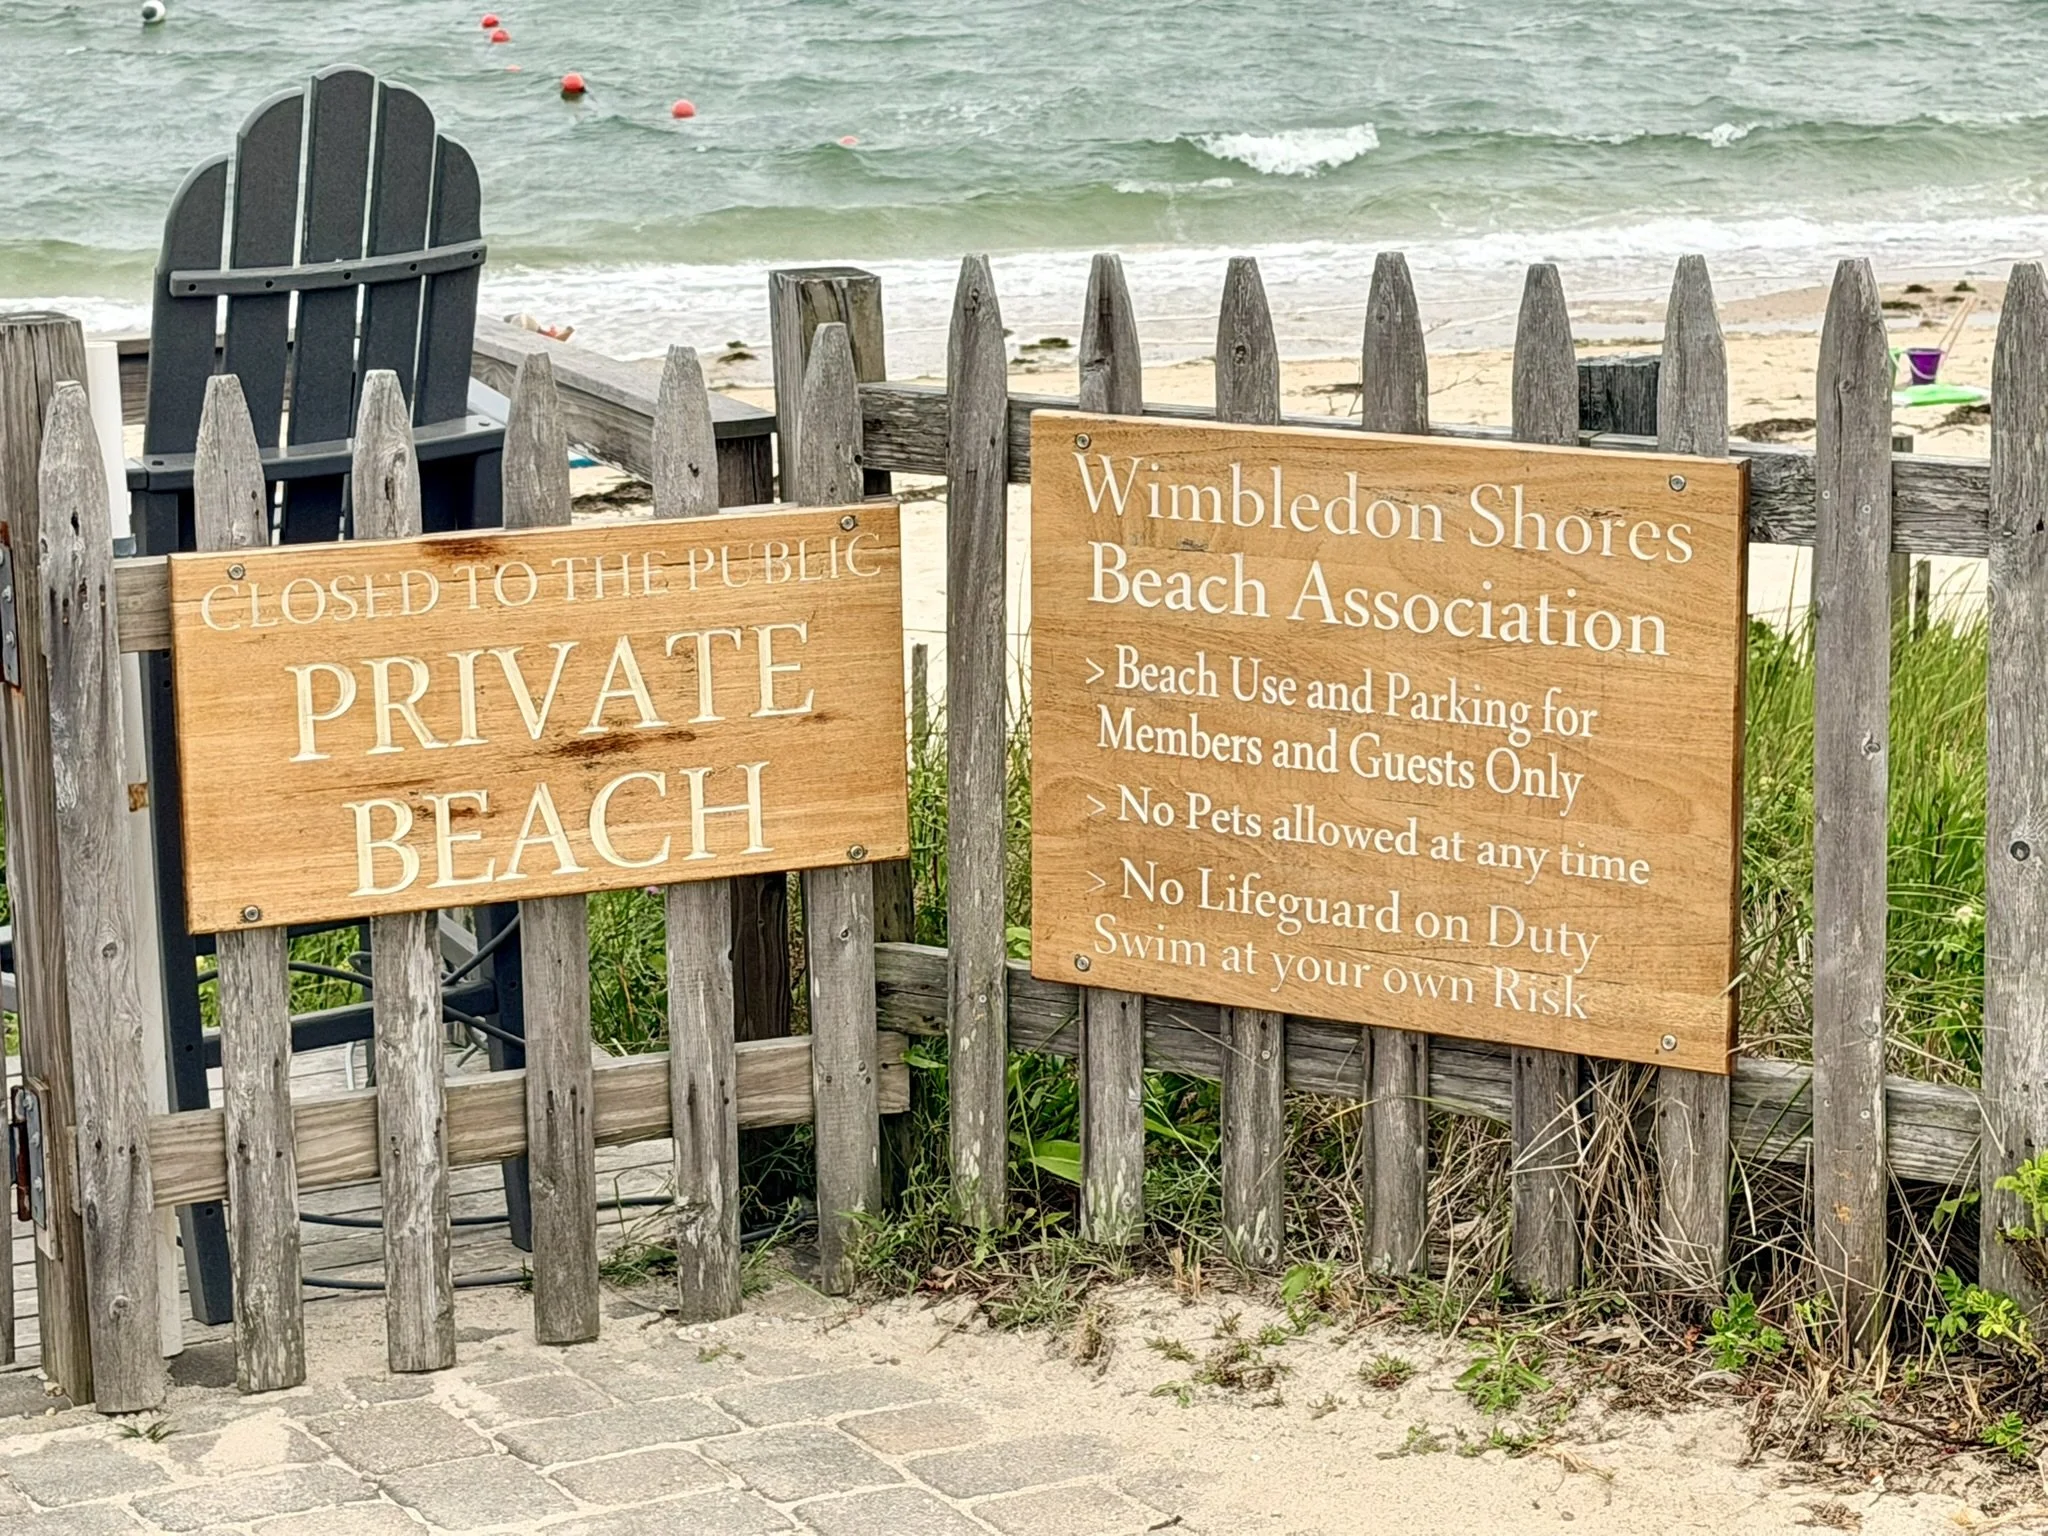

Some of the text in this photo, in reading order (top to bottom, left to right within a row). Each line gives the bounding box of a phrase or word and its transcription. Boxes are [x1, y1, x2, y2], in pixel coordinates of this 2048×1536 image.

[1073, 452, 1694, 564] Wimbledon Shores
[200, 532, 882, 632] CLOSED TO THE PUBLIC
[1087, 540, 1671, 656] Beach Association
[284, 620, 815, 763] PRIVATE
[1115, 643, 1598, 747] Beach Use and Parking for
[1096, 705, 1584, 817] Members and Guests Only
[341, 761, 774, 898] BEACH
[1117, 784, 1650, 886] No Pets allowed at any time
[1094, 912, 1589, 1020] Swim at your own Risk
[1119, 857, 1601, 974] No Lifeguard on Duty
